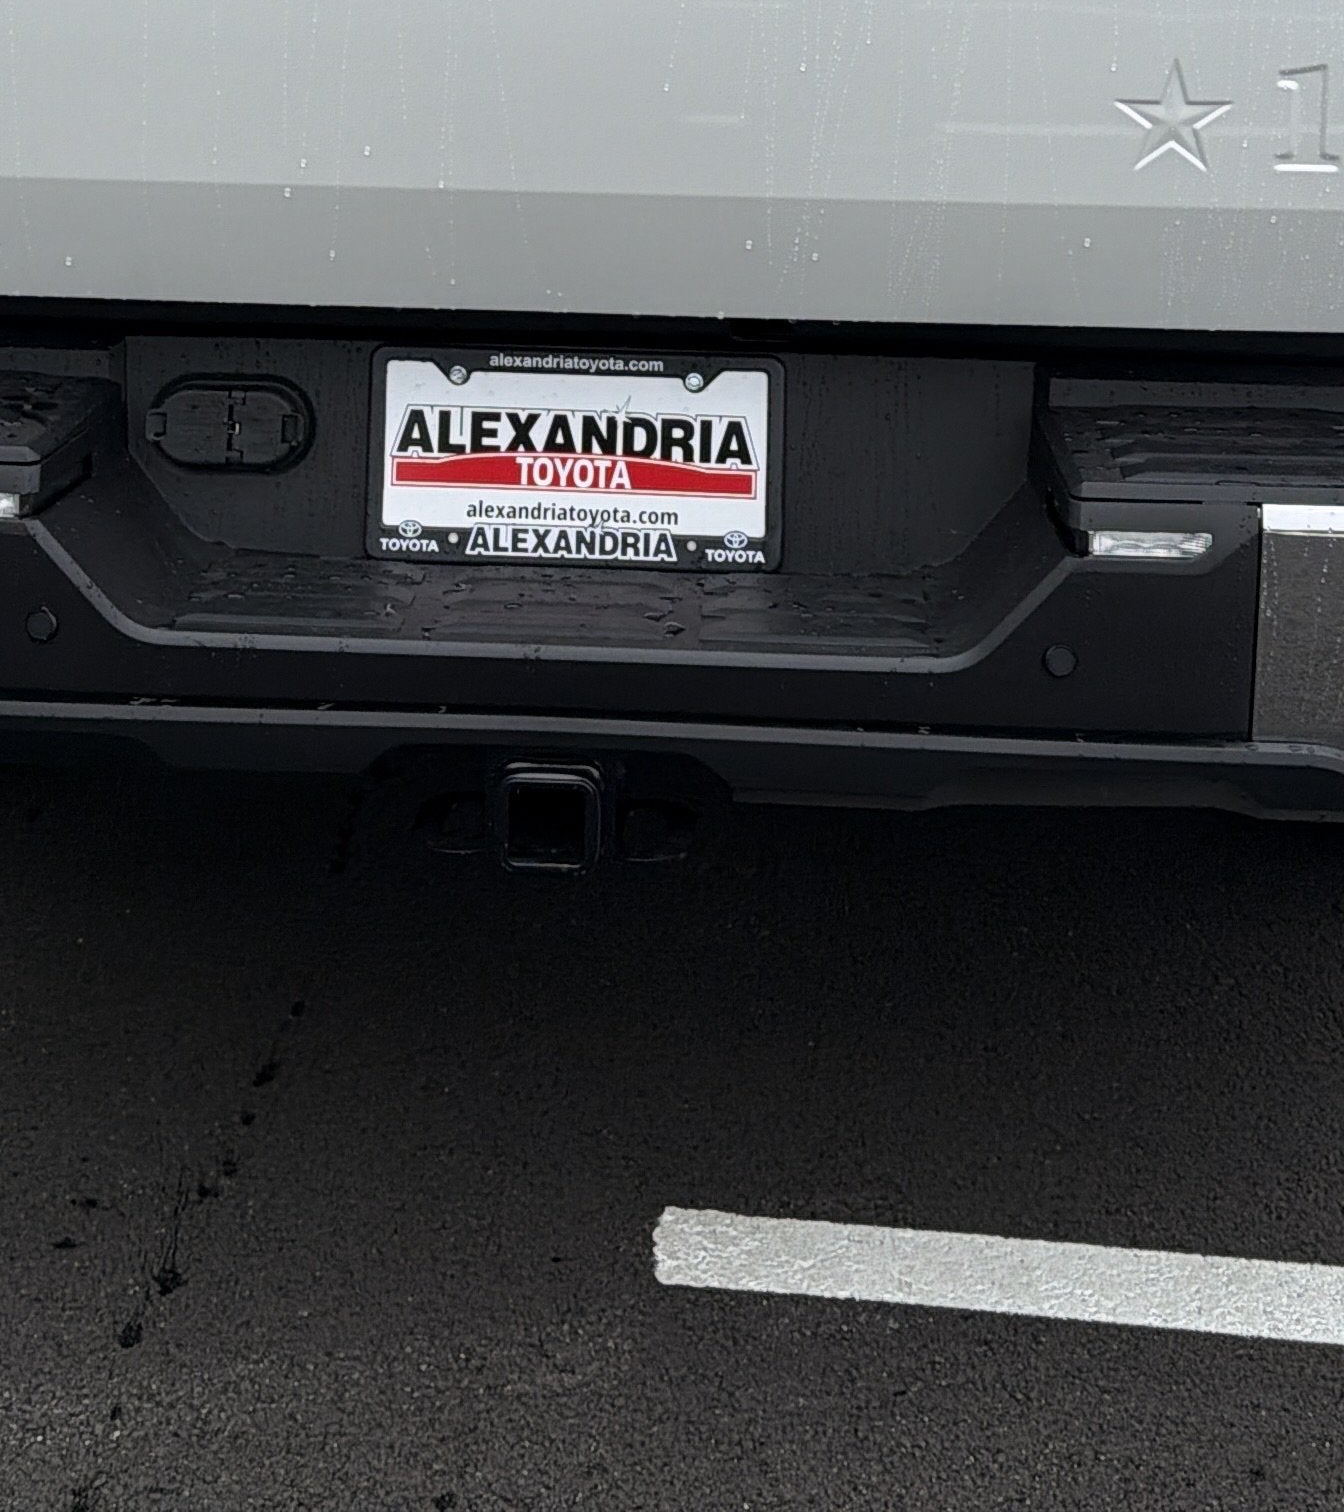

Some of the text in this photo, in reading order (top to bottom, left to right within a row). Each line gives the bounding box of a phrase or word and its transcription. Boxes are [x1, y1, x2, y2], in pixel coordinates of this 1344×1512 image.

[489, 354, 664, 373] alexandriatoyota.com
[396, 408, 754, 466] ALEXANDRIA
[516, 457, 632, 489] TOYOTA
[466, 500, 679, 526] alexandriatoyota.com
[380, 537, 439, 553] TOYOTA
[467, 526, 676, 560] ALEXANDRIA
[705, 548, 766, 564] TOYOTA
